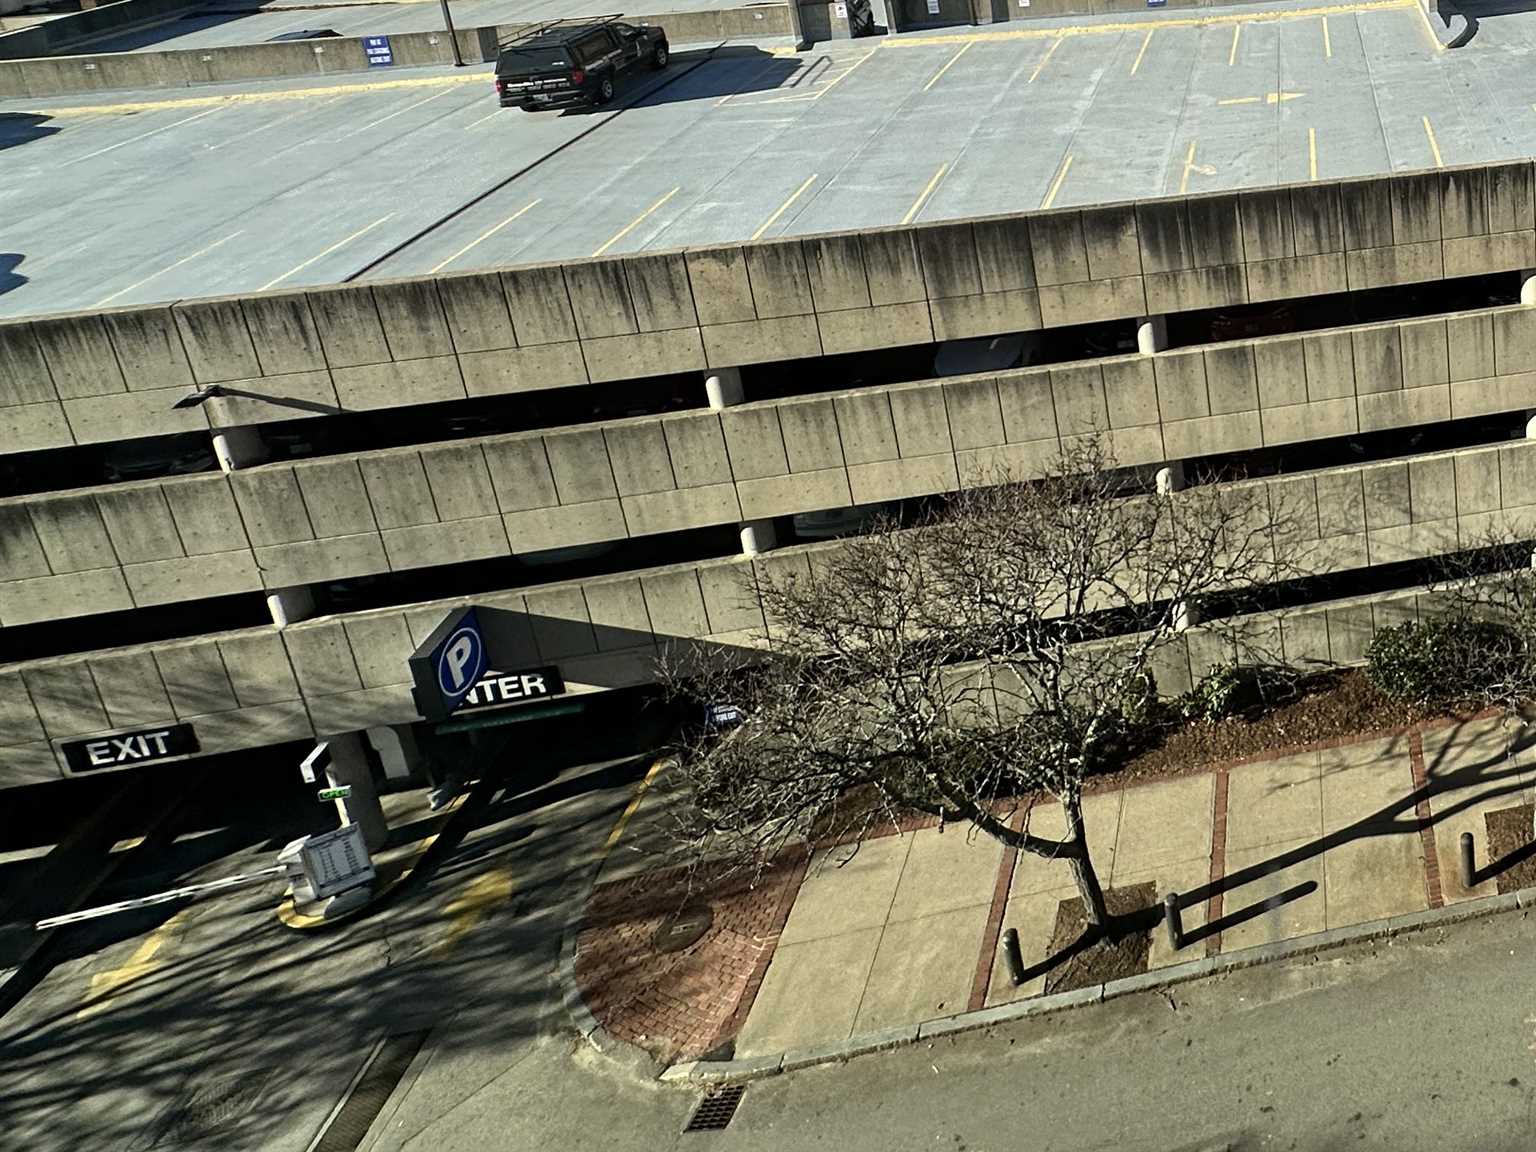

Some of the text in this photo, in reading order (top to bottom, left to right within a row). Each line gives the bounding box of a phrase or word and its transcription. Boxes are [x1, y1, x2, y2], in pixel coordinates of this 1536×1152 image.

[446, 636, 472, 689] P
[462, 674, 547, 705] NTER
[85, 730, 170, 766] EXIT
